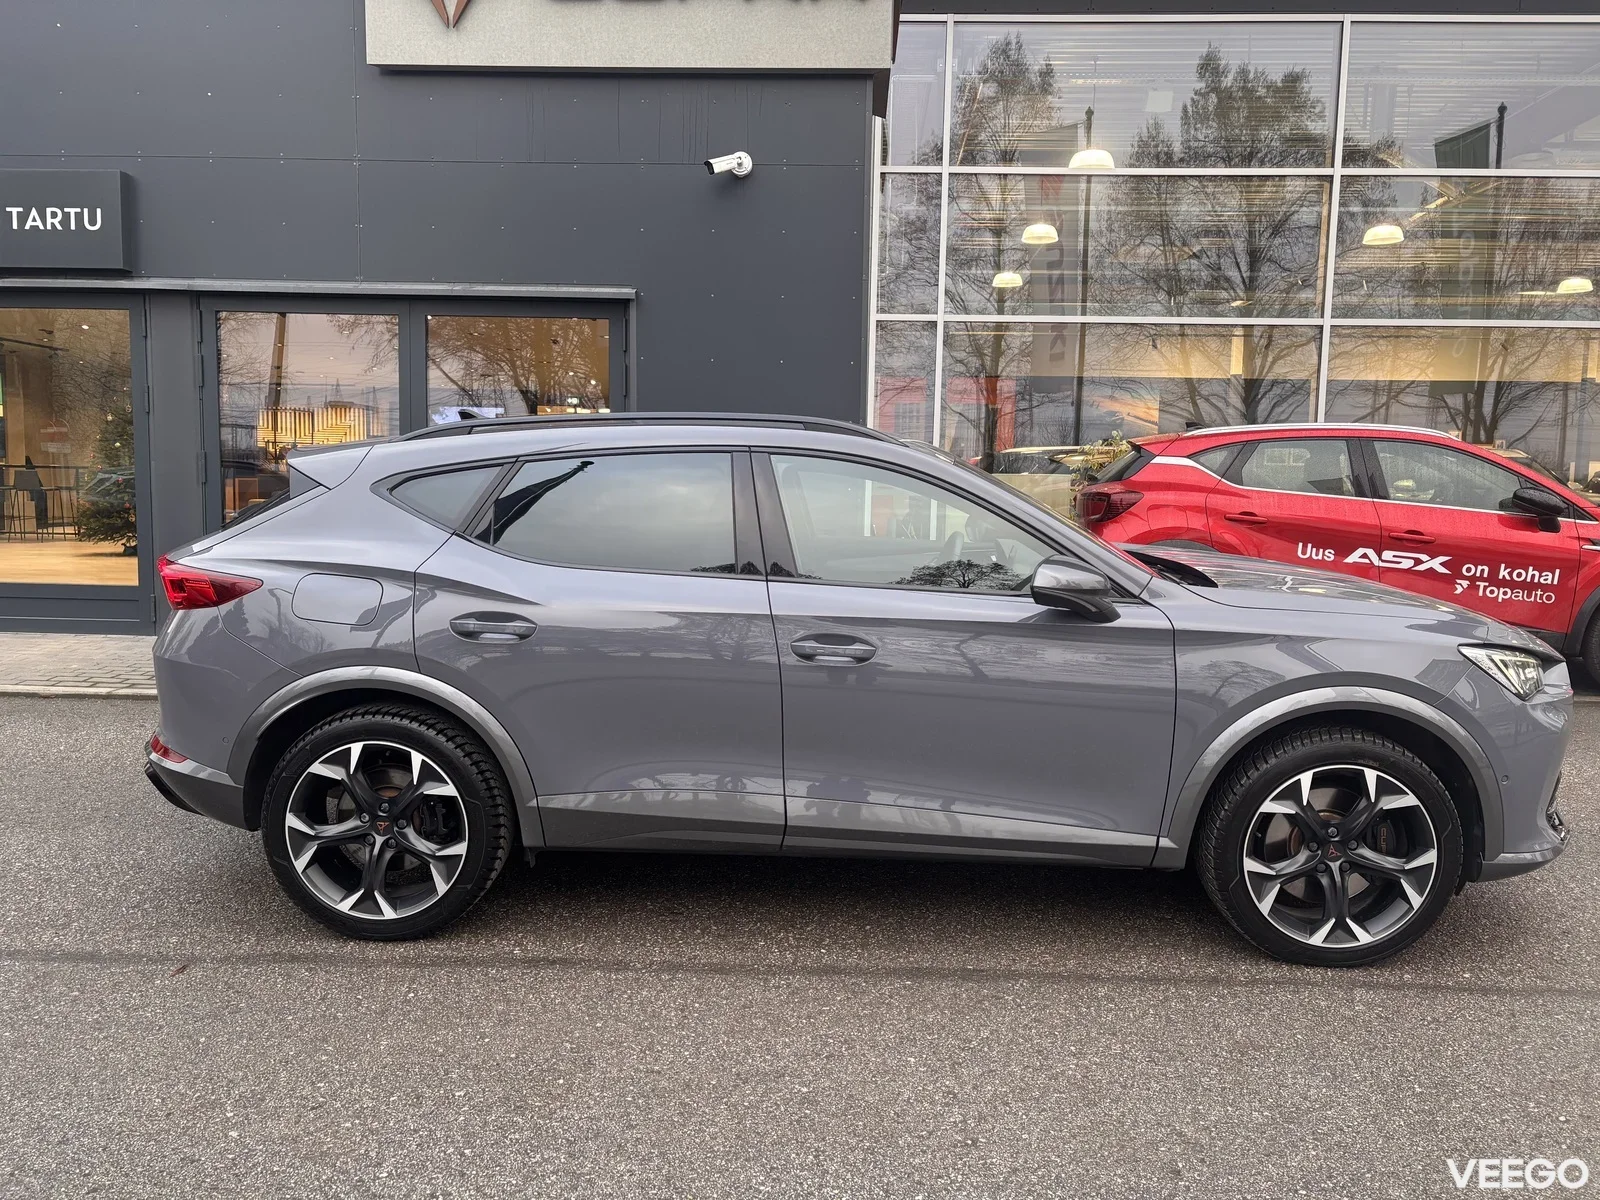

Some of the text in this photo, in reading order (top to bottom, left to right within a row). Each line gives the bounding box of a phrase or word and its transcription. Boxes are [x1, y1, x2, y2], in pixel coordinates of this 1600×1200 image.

[5, 206, 102, 231] TARTU
[1296, 542, 1561, 586] Uus ASX on kohal
[1475, 581, 1556, 604] Topauto
